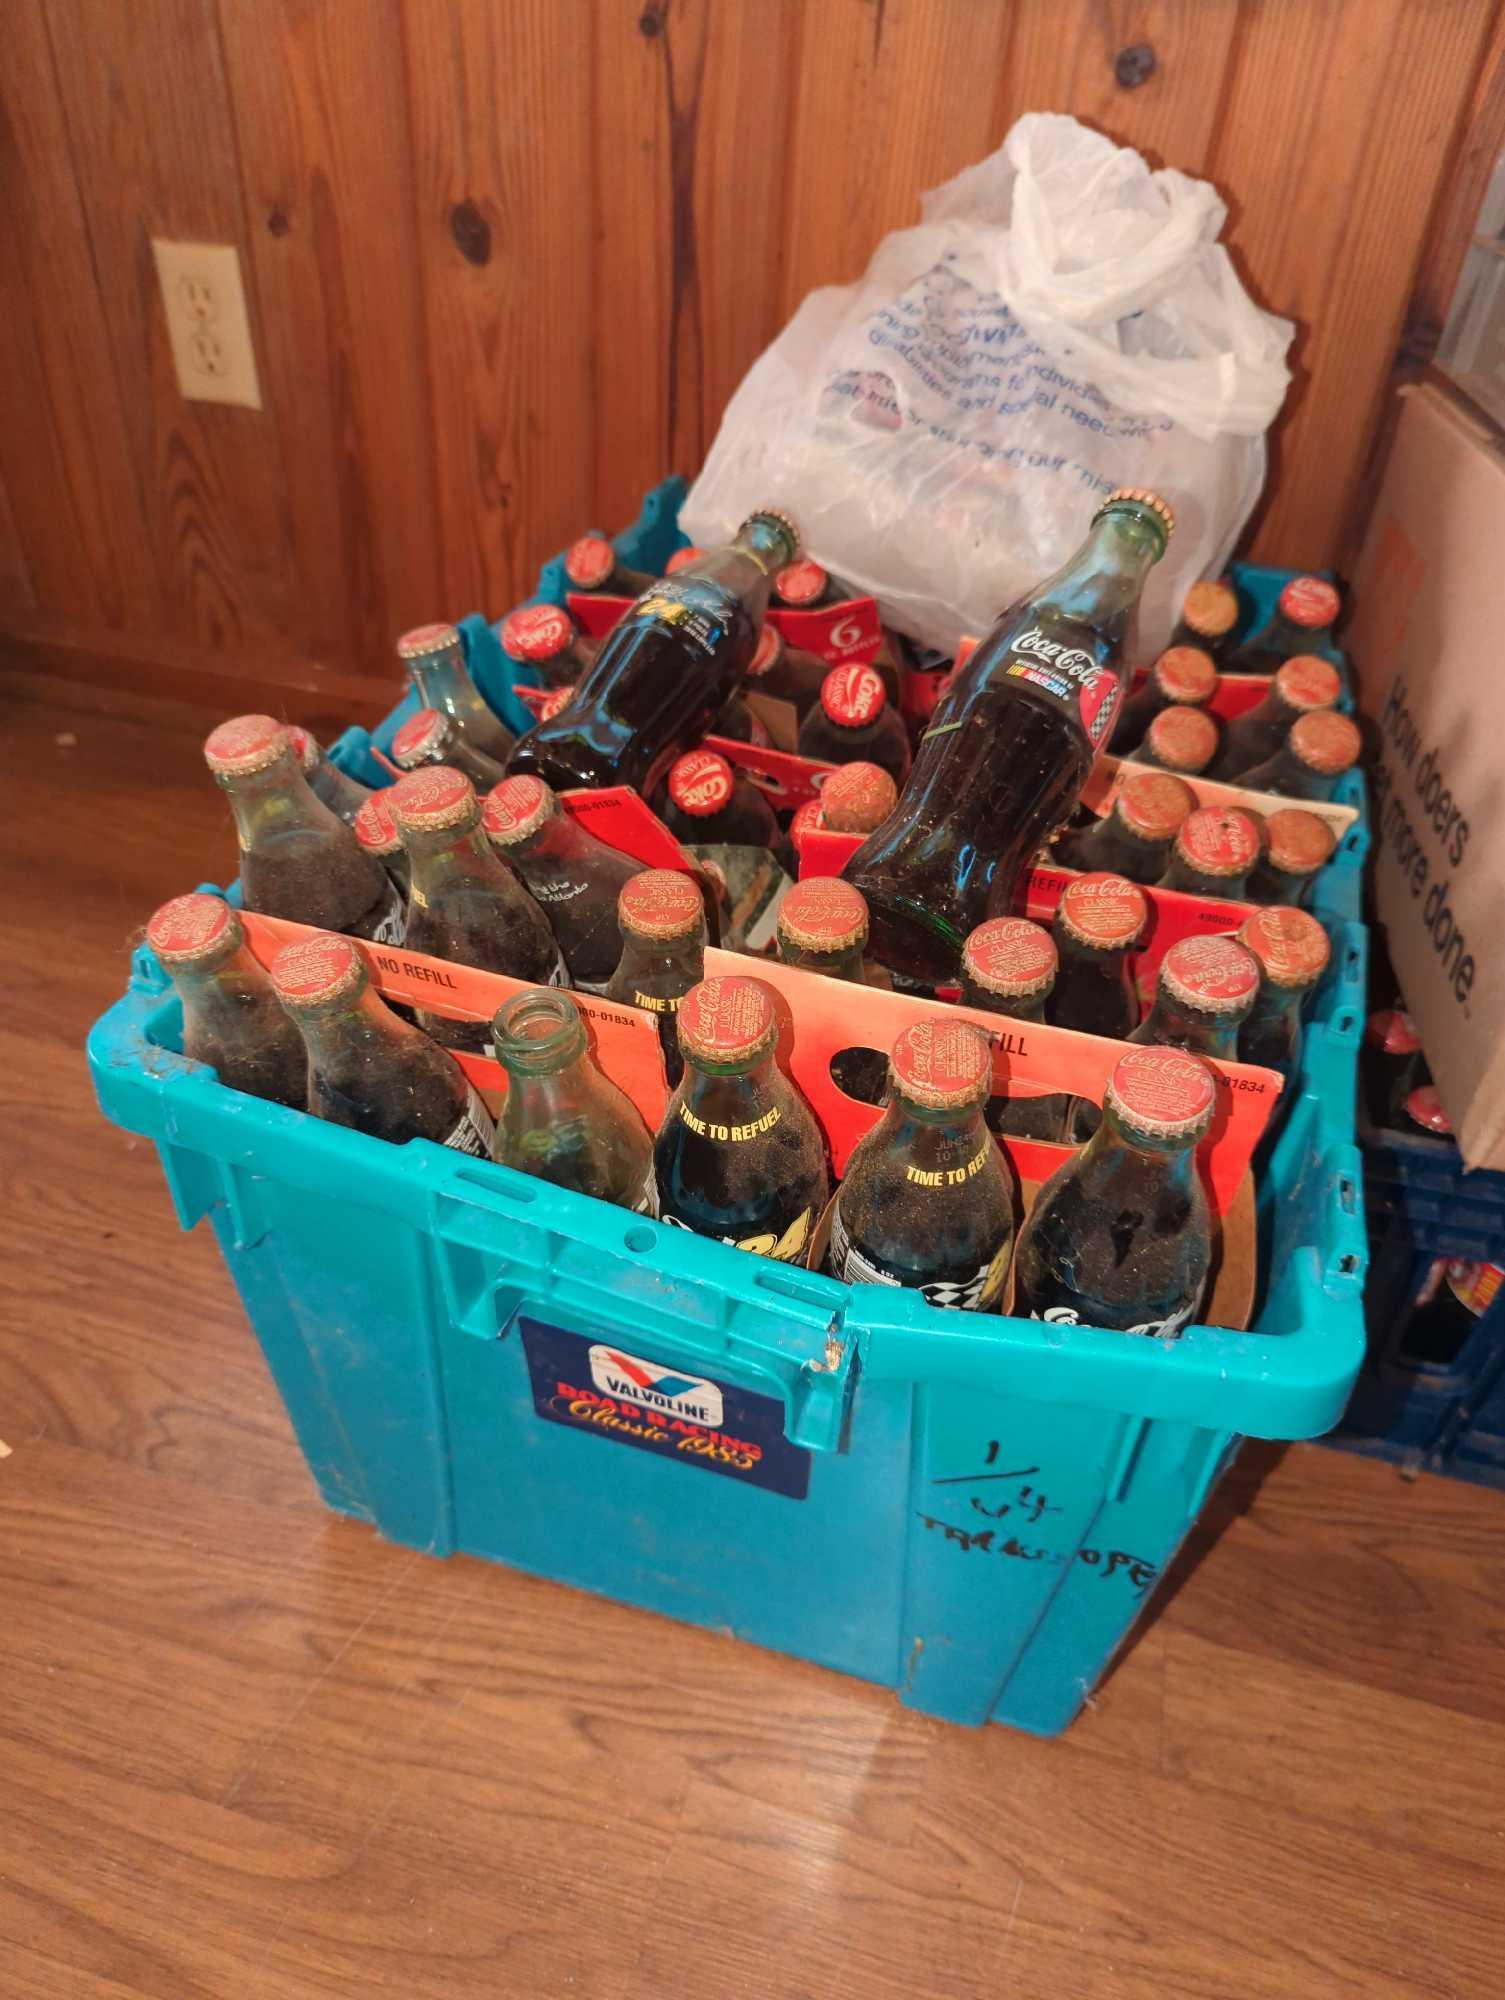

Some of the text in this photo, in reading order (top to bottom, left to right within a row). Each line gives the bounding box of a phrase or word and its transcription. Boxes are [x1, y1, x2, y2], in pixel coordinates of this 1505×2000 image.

[830, 616, 862, 649] 6
[1011, 627, 1104, 690] Coca-Cola
[855, 672, 882, 720] Coke
[1027, 672, 1067, 698] NASCAR
[682, 776, 728, 806] Coke
[1383, 676, 1472, 867] How doers
[1383, 799, 1428, 899] more
[1066, 879, 1141, 899] Coca-Cola
[968, 921, 1046, 951] Coca-Cola
[377, 955, 457, 989] NO REFILL
[635, 990, 666, 1012] TIME
[694, 976, 726, 1045] Coca-Cola
[907, 1017, 937, 1090] Coca-Cola
[1119, 1053, 1210, 1087] Coca-Cola
[679, 1099, 782, 1142] TIME TO REFUEL
[906, 1165, 944, 1187] TIME
[947, 1168, 966, 1185] TO
[554, 1397, 671, 1443] Classic
[606, 1376, 711, 1422] VALVOLINE
[556, 1382, 763, 1460] ROAD RACING
